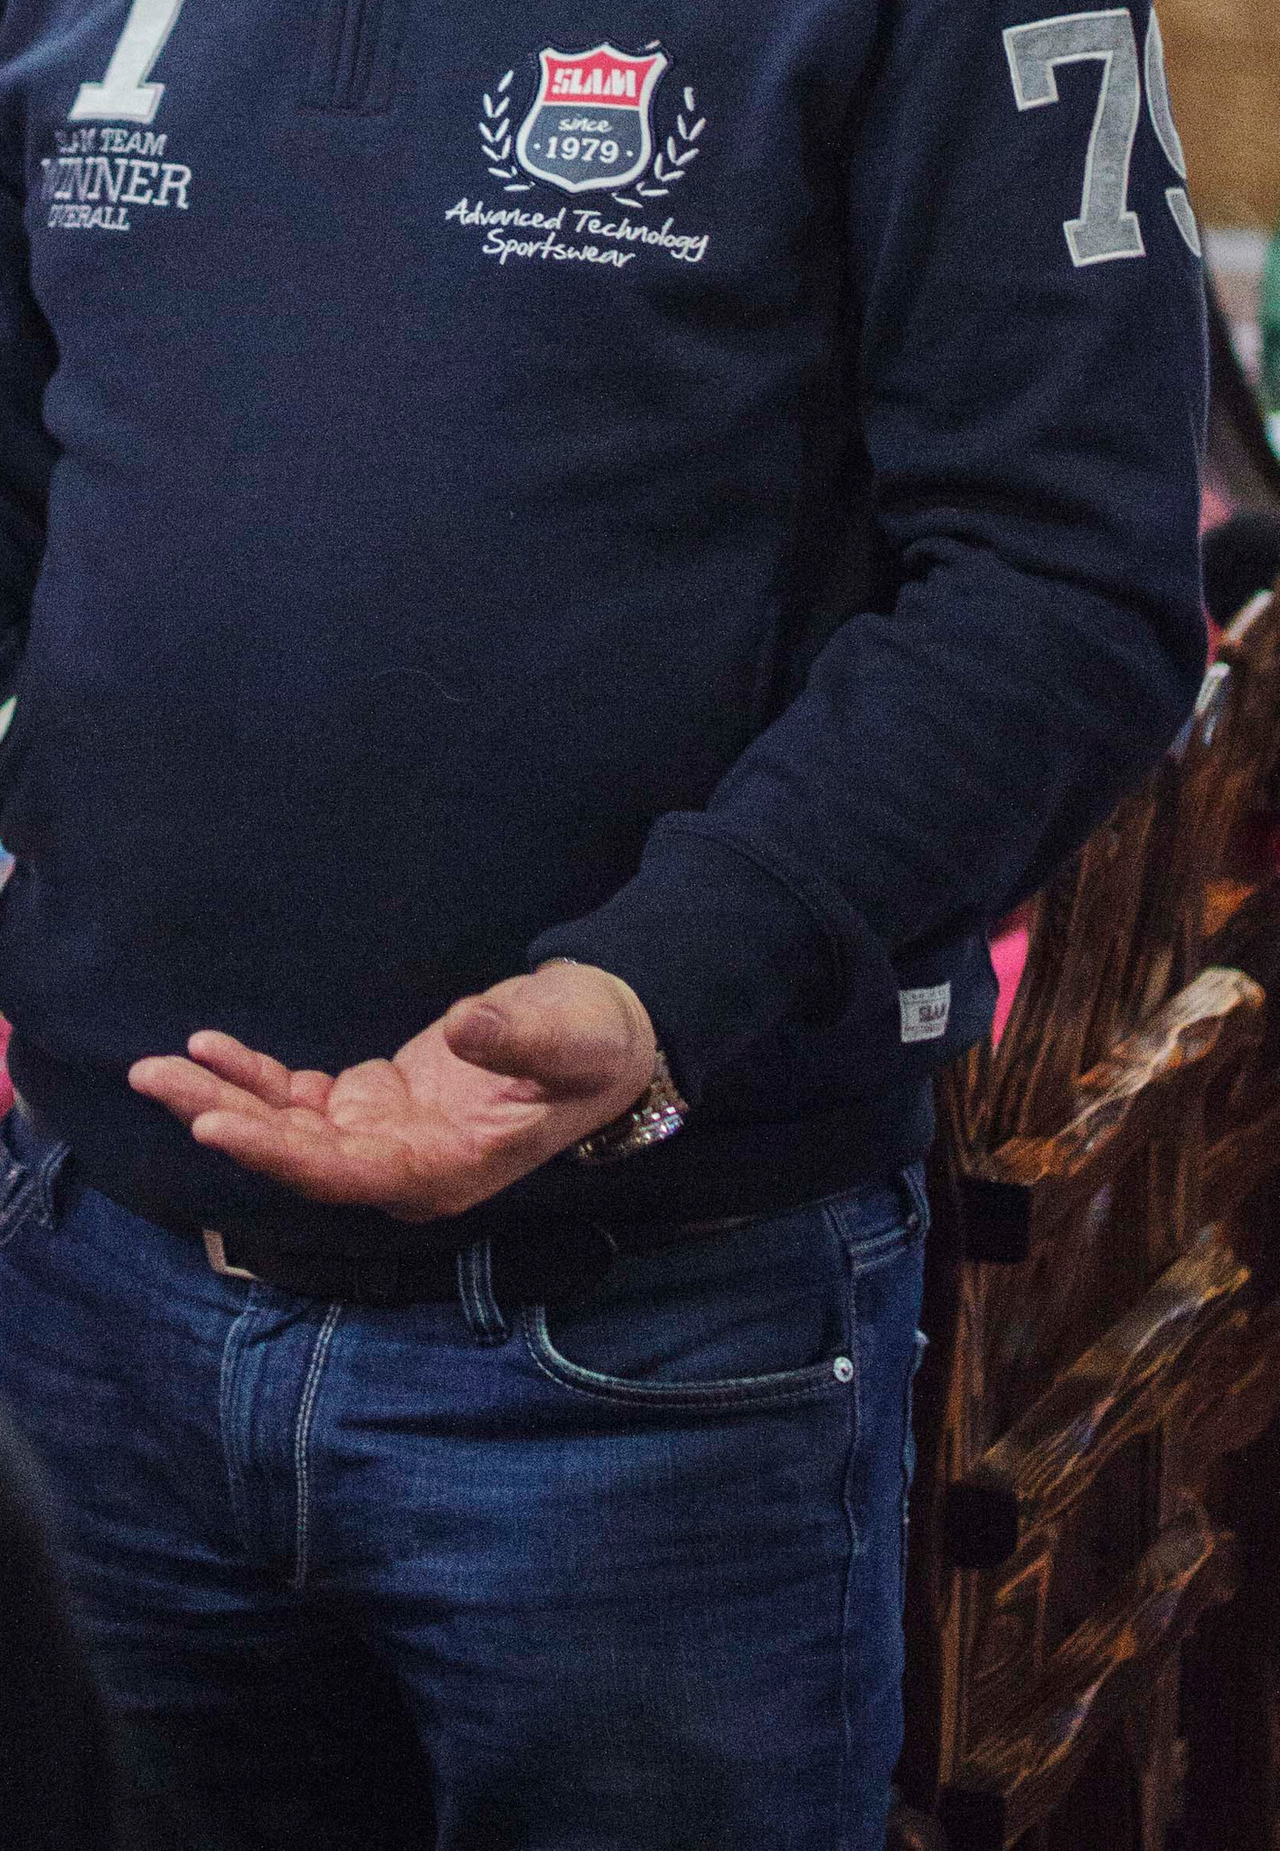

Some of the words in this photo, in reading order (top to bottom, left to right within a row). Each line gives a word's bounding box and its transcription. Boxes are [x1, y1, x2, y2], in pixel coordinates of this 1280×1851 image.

[551, 68, 636, 97] SLAM
[558, 115, 612, 133] since
[99, 127, 168, 156] TEAM
[546, 136, 620, 164] 1979
[445, 198, 566, 230] Advanced
[572, 209, 709, 263] Technology
[482, 228, 636, 268] Sportswear
